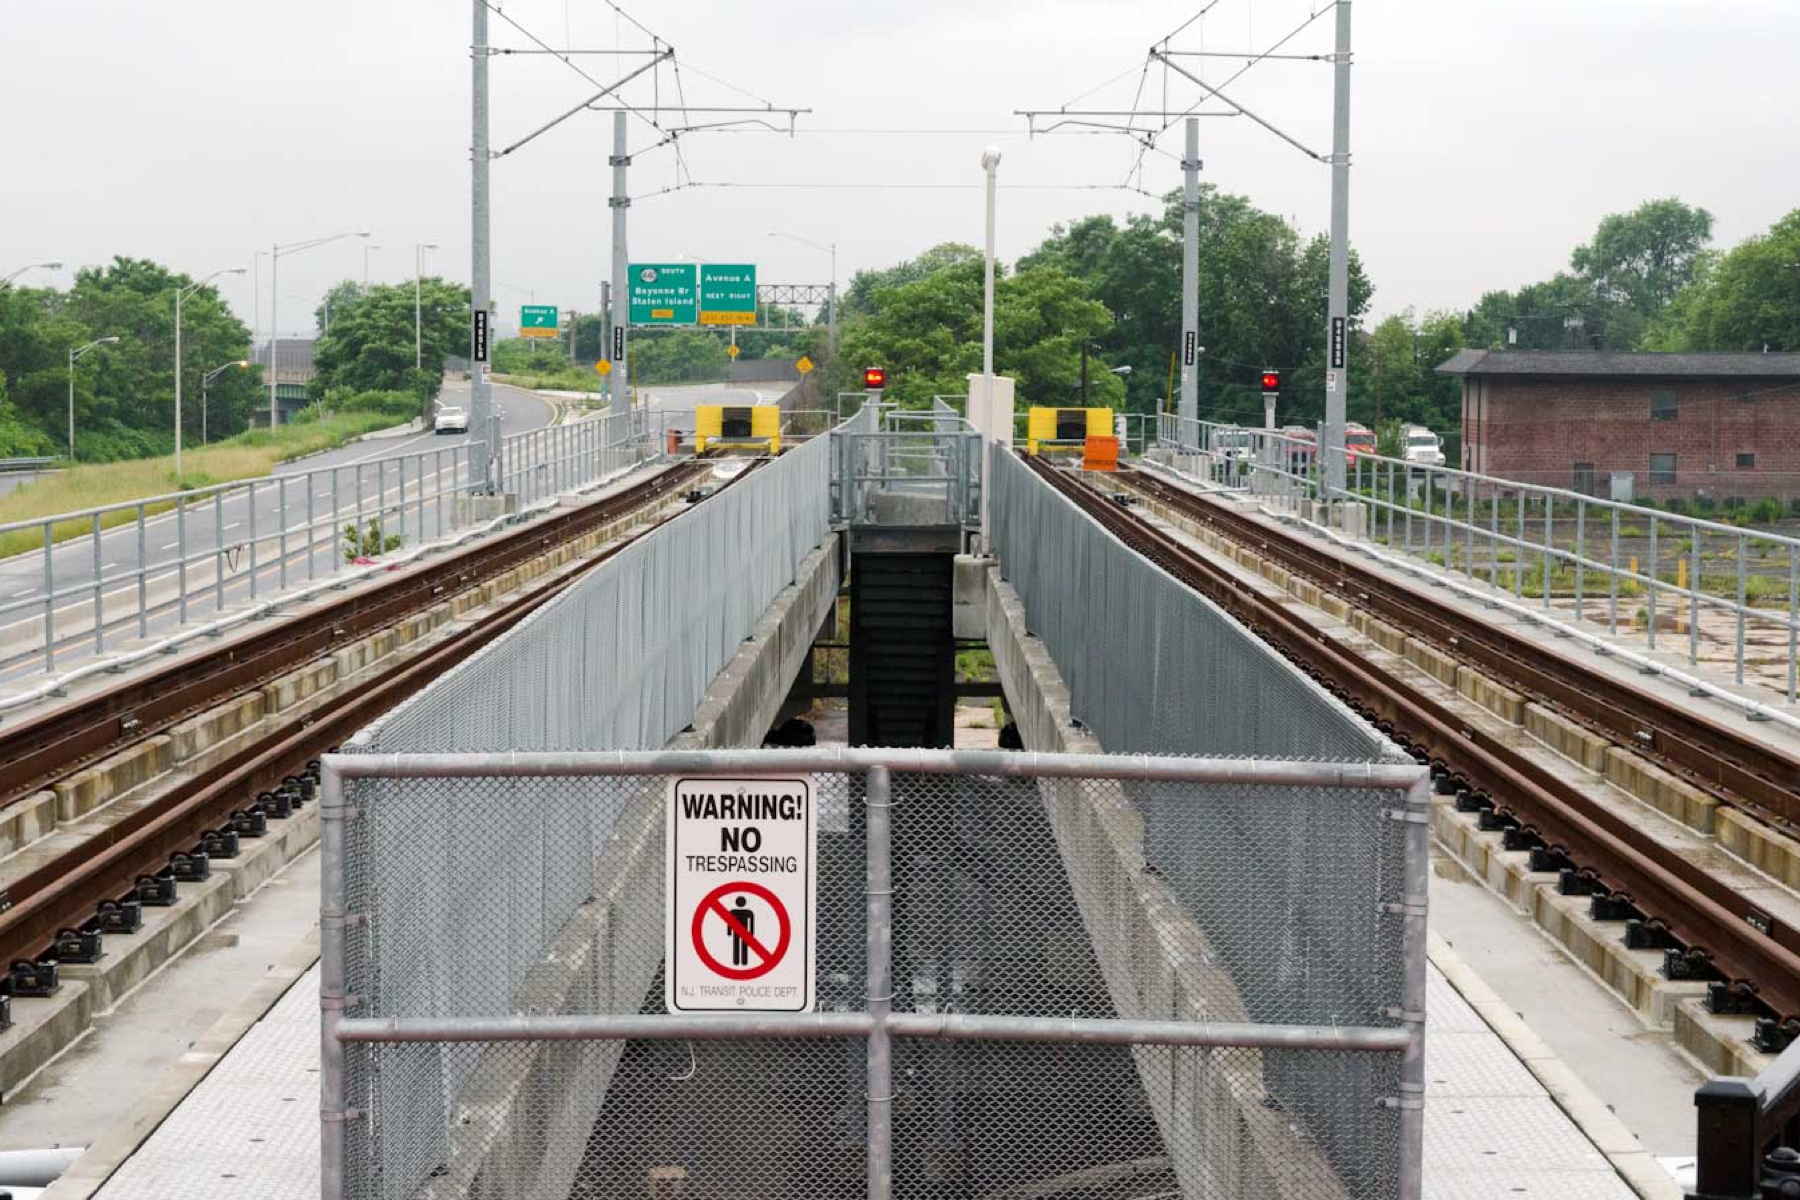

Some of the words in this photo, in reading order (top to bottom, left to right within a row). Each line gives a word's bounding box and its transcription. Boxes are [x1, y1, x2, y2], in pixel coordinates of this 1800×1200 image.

[635, 287, 674, 297] Bayonne
[632, 297, 661, 305] Staten
[665, 297, 693, 305] Island
[682, 794, 802, 820] WARNING!
[721, 827, 762, 853] NO
[686, 855, 798, 873] TRESPASSING
[700, 985, 737, 998] TRANSIT
[739, 985, 773, 998] POLICE
